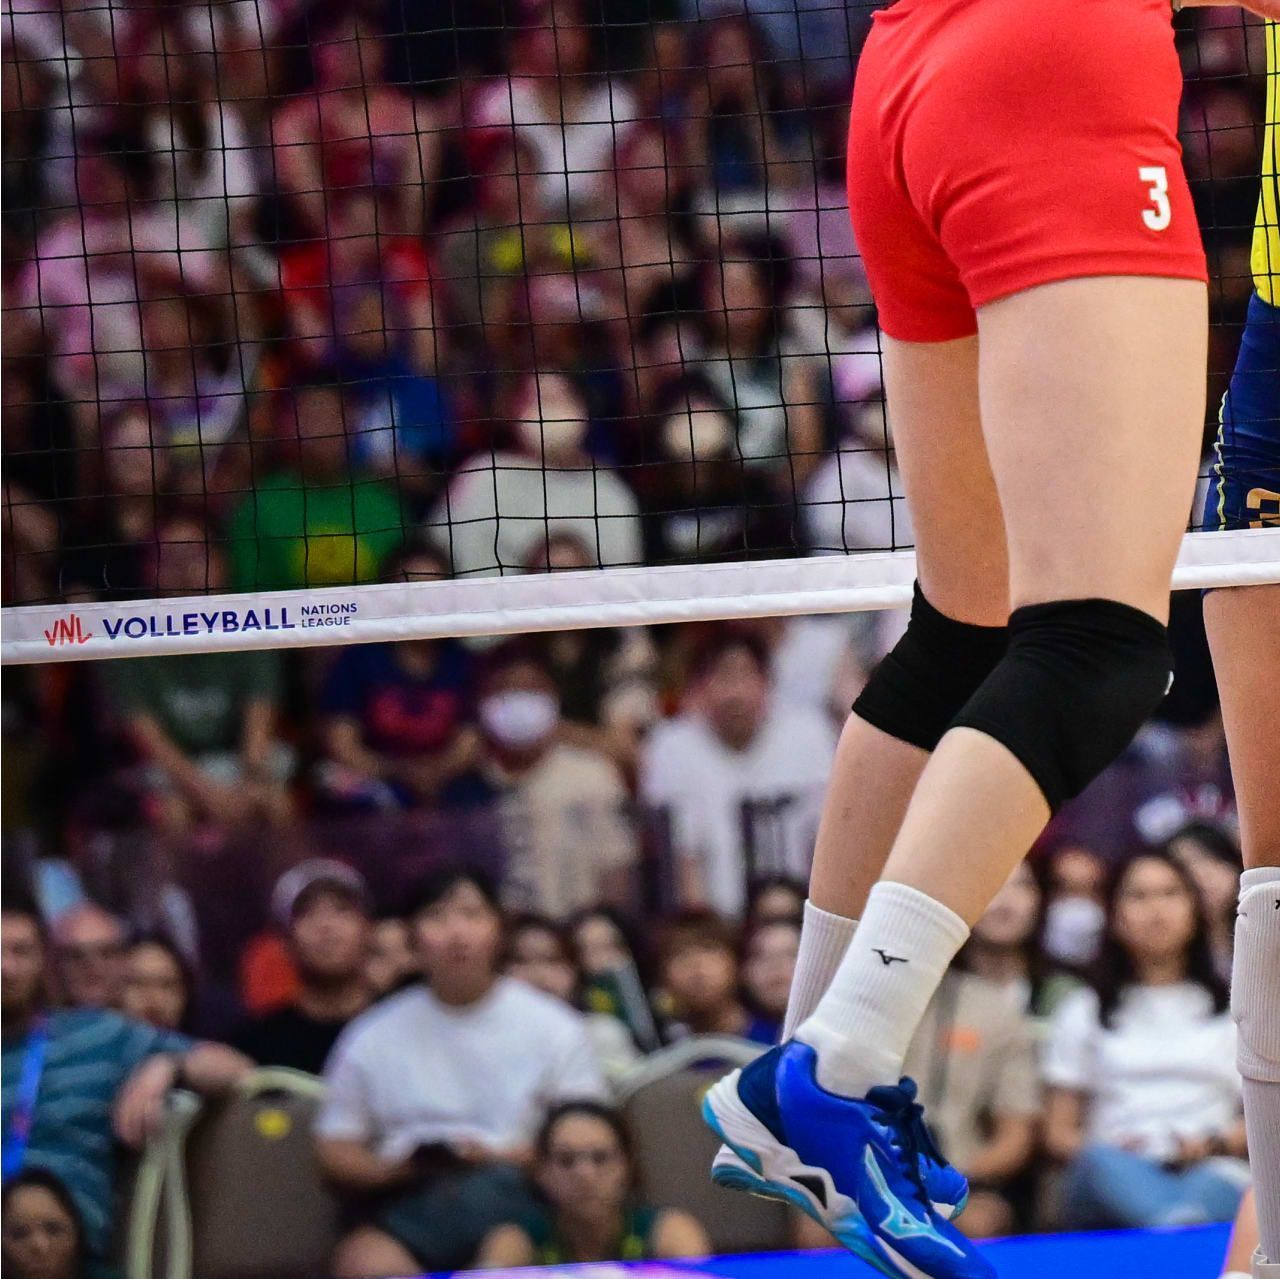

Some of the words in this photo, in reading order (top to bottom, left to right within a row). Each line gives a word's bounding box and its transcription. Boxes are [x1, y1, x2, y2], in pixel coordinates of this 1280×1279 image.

[1137, 166, 1172, 232] 3
[301, 602, 358, 617] NATIONS
[301, 616, 352, 629] LEAGUE
[43, 613, 93, 646] VNL
[102, 607, 296, 640] VOLLEYBALL
